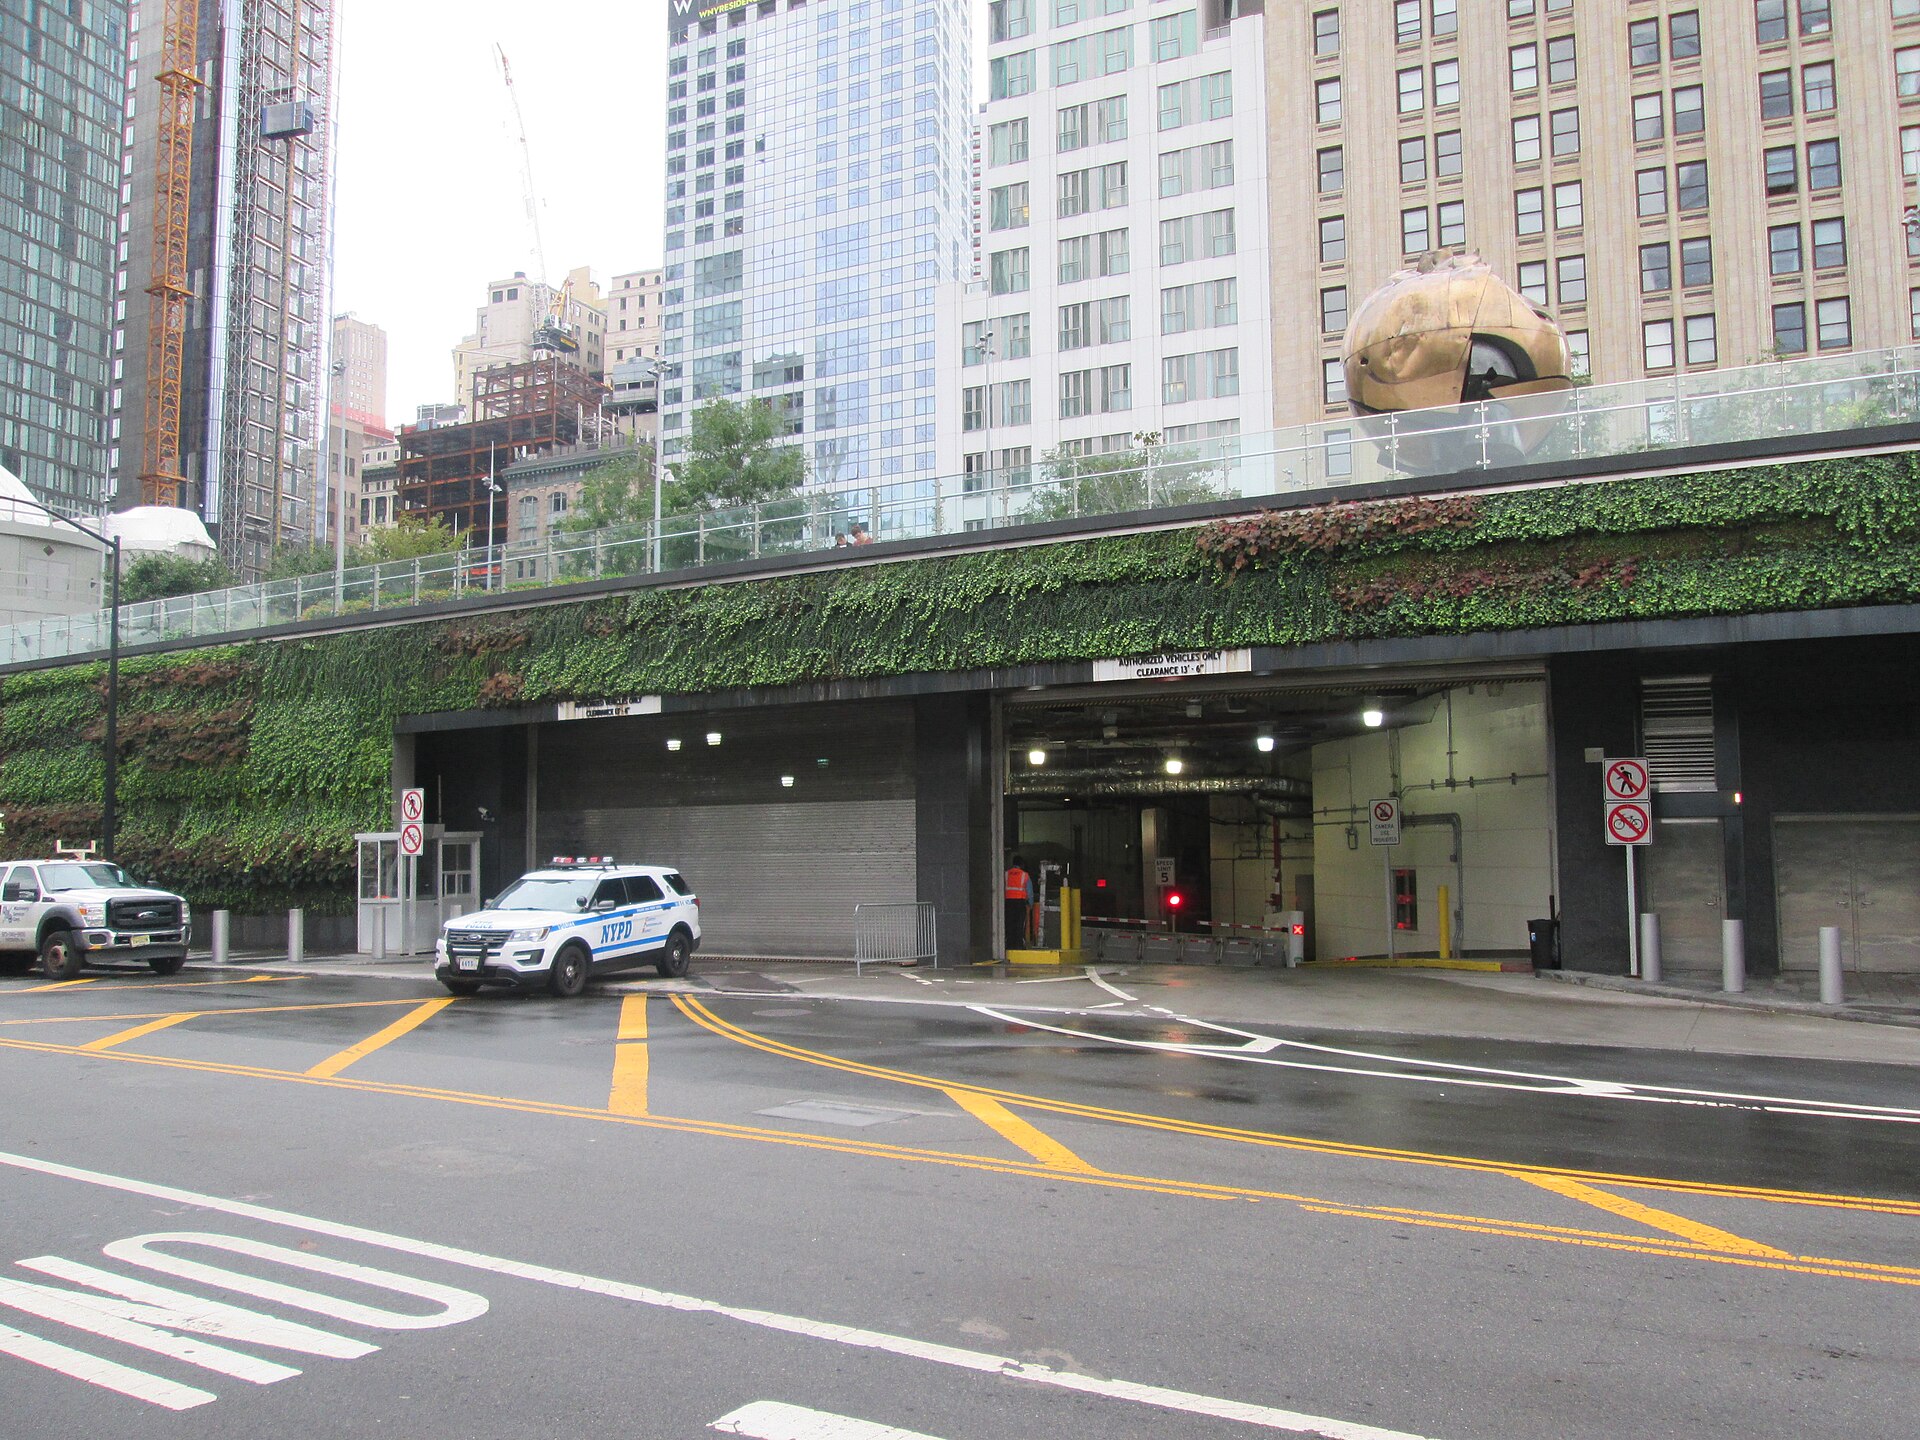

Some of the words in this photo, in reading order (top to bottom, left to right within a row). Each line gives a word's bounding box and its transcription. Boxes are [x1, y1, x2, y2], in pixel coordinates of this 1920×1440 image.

[674, 0, 692, 16] W
[1119, 655, 1163, 666] AUTHORIZED
[1166, 652, 1200, 663] VEHICLES
[1202, 650, 1222, 661] ONLY
[1136, 666, 1179, 677] CLEARANCE
[1161, 872, 1169, 883] 5
[601, 920, 632, 944] NYPD
